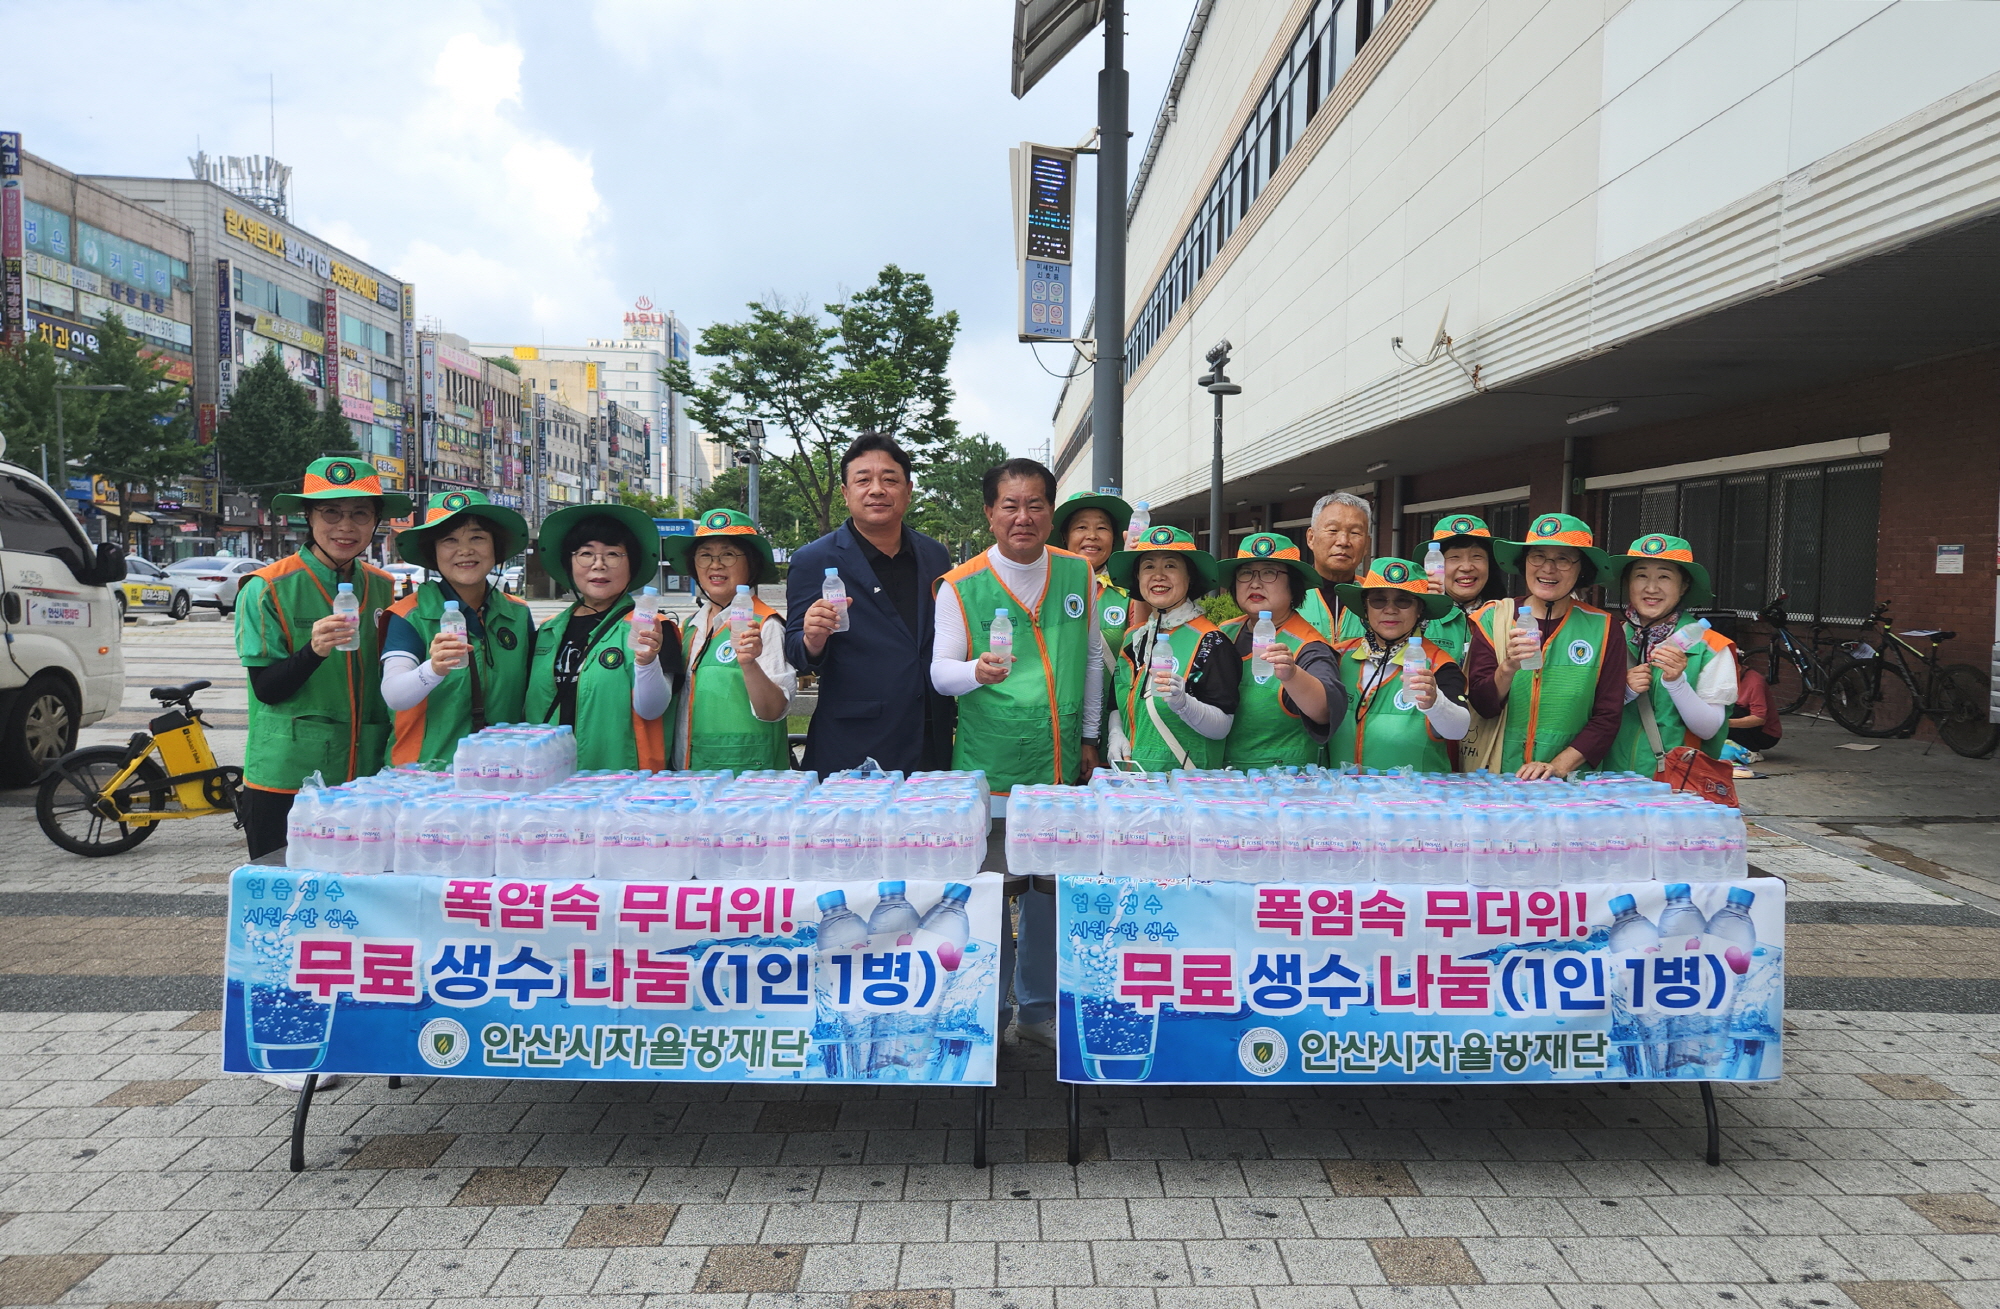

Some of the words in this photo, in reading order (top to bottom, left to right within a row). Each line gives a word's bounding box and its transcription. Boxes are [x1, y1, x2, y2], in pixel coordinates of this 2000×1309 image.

[1037, 263, 1060, 273] 미세먼지
[623, 312, 664, 325] 사우나
[630, 325, 659, 338] 24시
[1043, 327, 1062, 335] 안산시
[221, 362, 231, 381] 네일
[244, 907, 318, 928] 시원~한
[324, 908, 359, 929] 생수
[443, 880, 601, 931] 폭염속
[620, 884, 795, 934] 무더위!
[1256, 888, 1406, 937] 폭염속
[1425, 890, 1588, 938] 무더위!
[1070, 920, 1140, 941] 시원~한
[1143, 921, 1180, 941] 생수
[295, 940, 418, 997] 무료
[430, 943, 555, 1002] 생수
[573, 947, 690, 1004] 나눔
[701, 950, 809, 1007] (1인
[830, 949, 937, 1008] 1병)
[1120, 953, 1235, 1008] 무료
[1248, 953, 1362, 1010] 생수
[1379, 953, 1491, 1010] 나눔
[1501, 955, 1606, 1012] (1인
[1625, 953, 1727, 1011] 1병)
[483, 1025, 811, 1070] 안산시자율방재단
[1301, 1031, 1609, 1074] 안산시자율방재단
